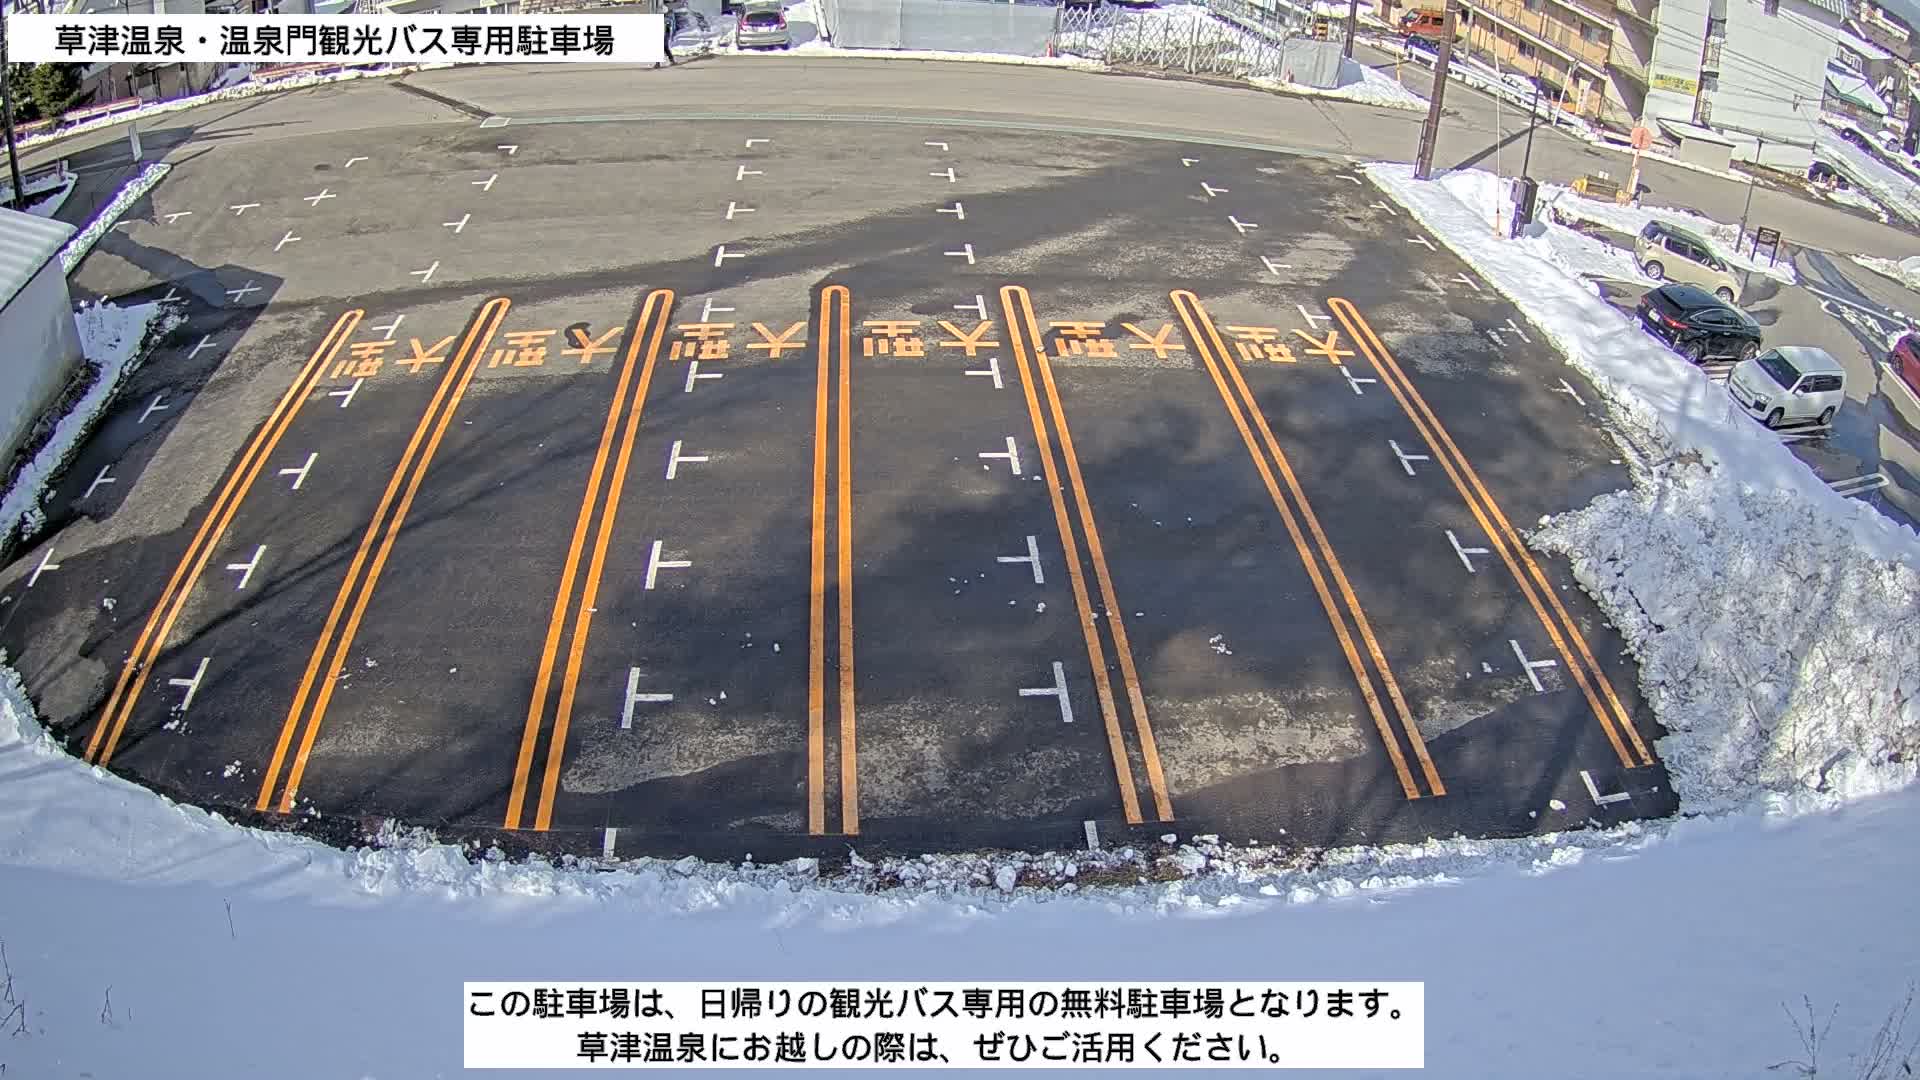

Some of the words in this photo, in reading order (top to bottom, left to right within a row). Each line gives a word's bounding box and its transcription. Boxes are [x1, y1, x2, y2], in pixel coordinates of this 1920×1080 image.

[331, 335, 456, 379] 大型
[488, 328, 624, 369] 大型
[669, 321, 807, 361] 大型
[862, 320, 1000, 357] 大型
[1049, 321, 1186, 359] 大型
[1225, 325, 1355, 365] 大型
